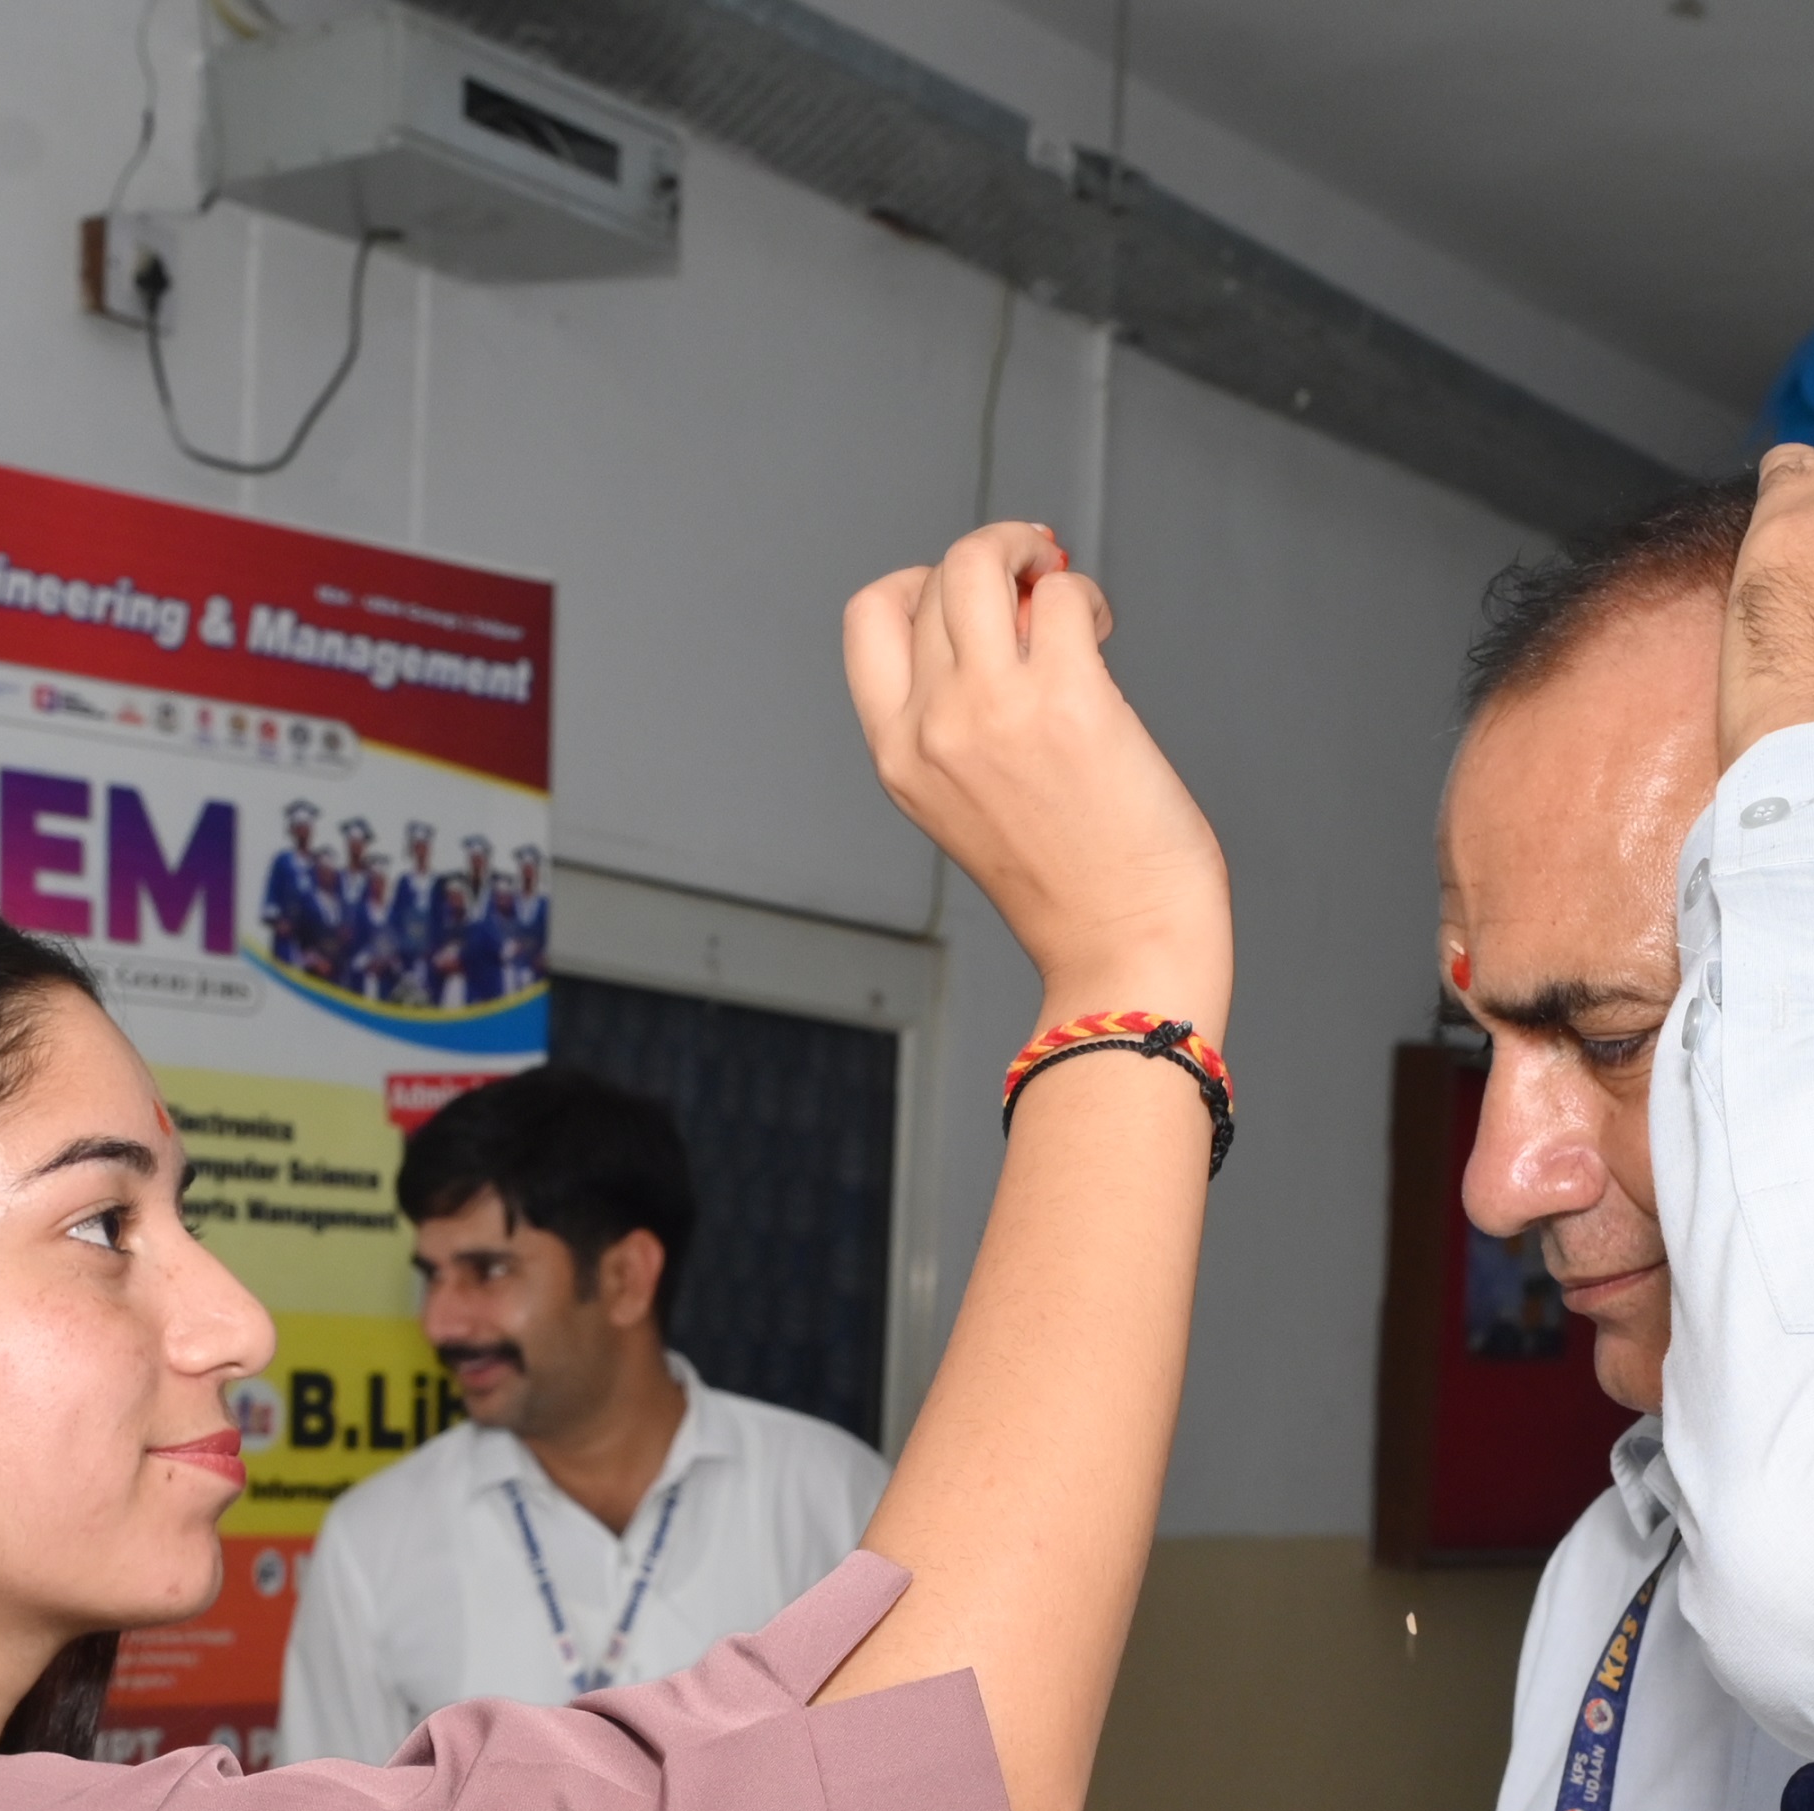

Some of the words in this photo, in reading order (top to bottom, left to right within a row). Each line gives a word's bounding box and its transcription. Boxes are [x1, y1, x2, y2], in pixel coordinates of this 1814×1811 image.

[198, 593, 235, 649] &
[246, 603, 534, 704] Management
[247, 1197, 398, 1235] Management
[1596, 1614, 1639, 1692] KPS
[1569, 1750, 1589, 1786] KPS
[1582, 1743, 1607, 1803] UDAAN
